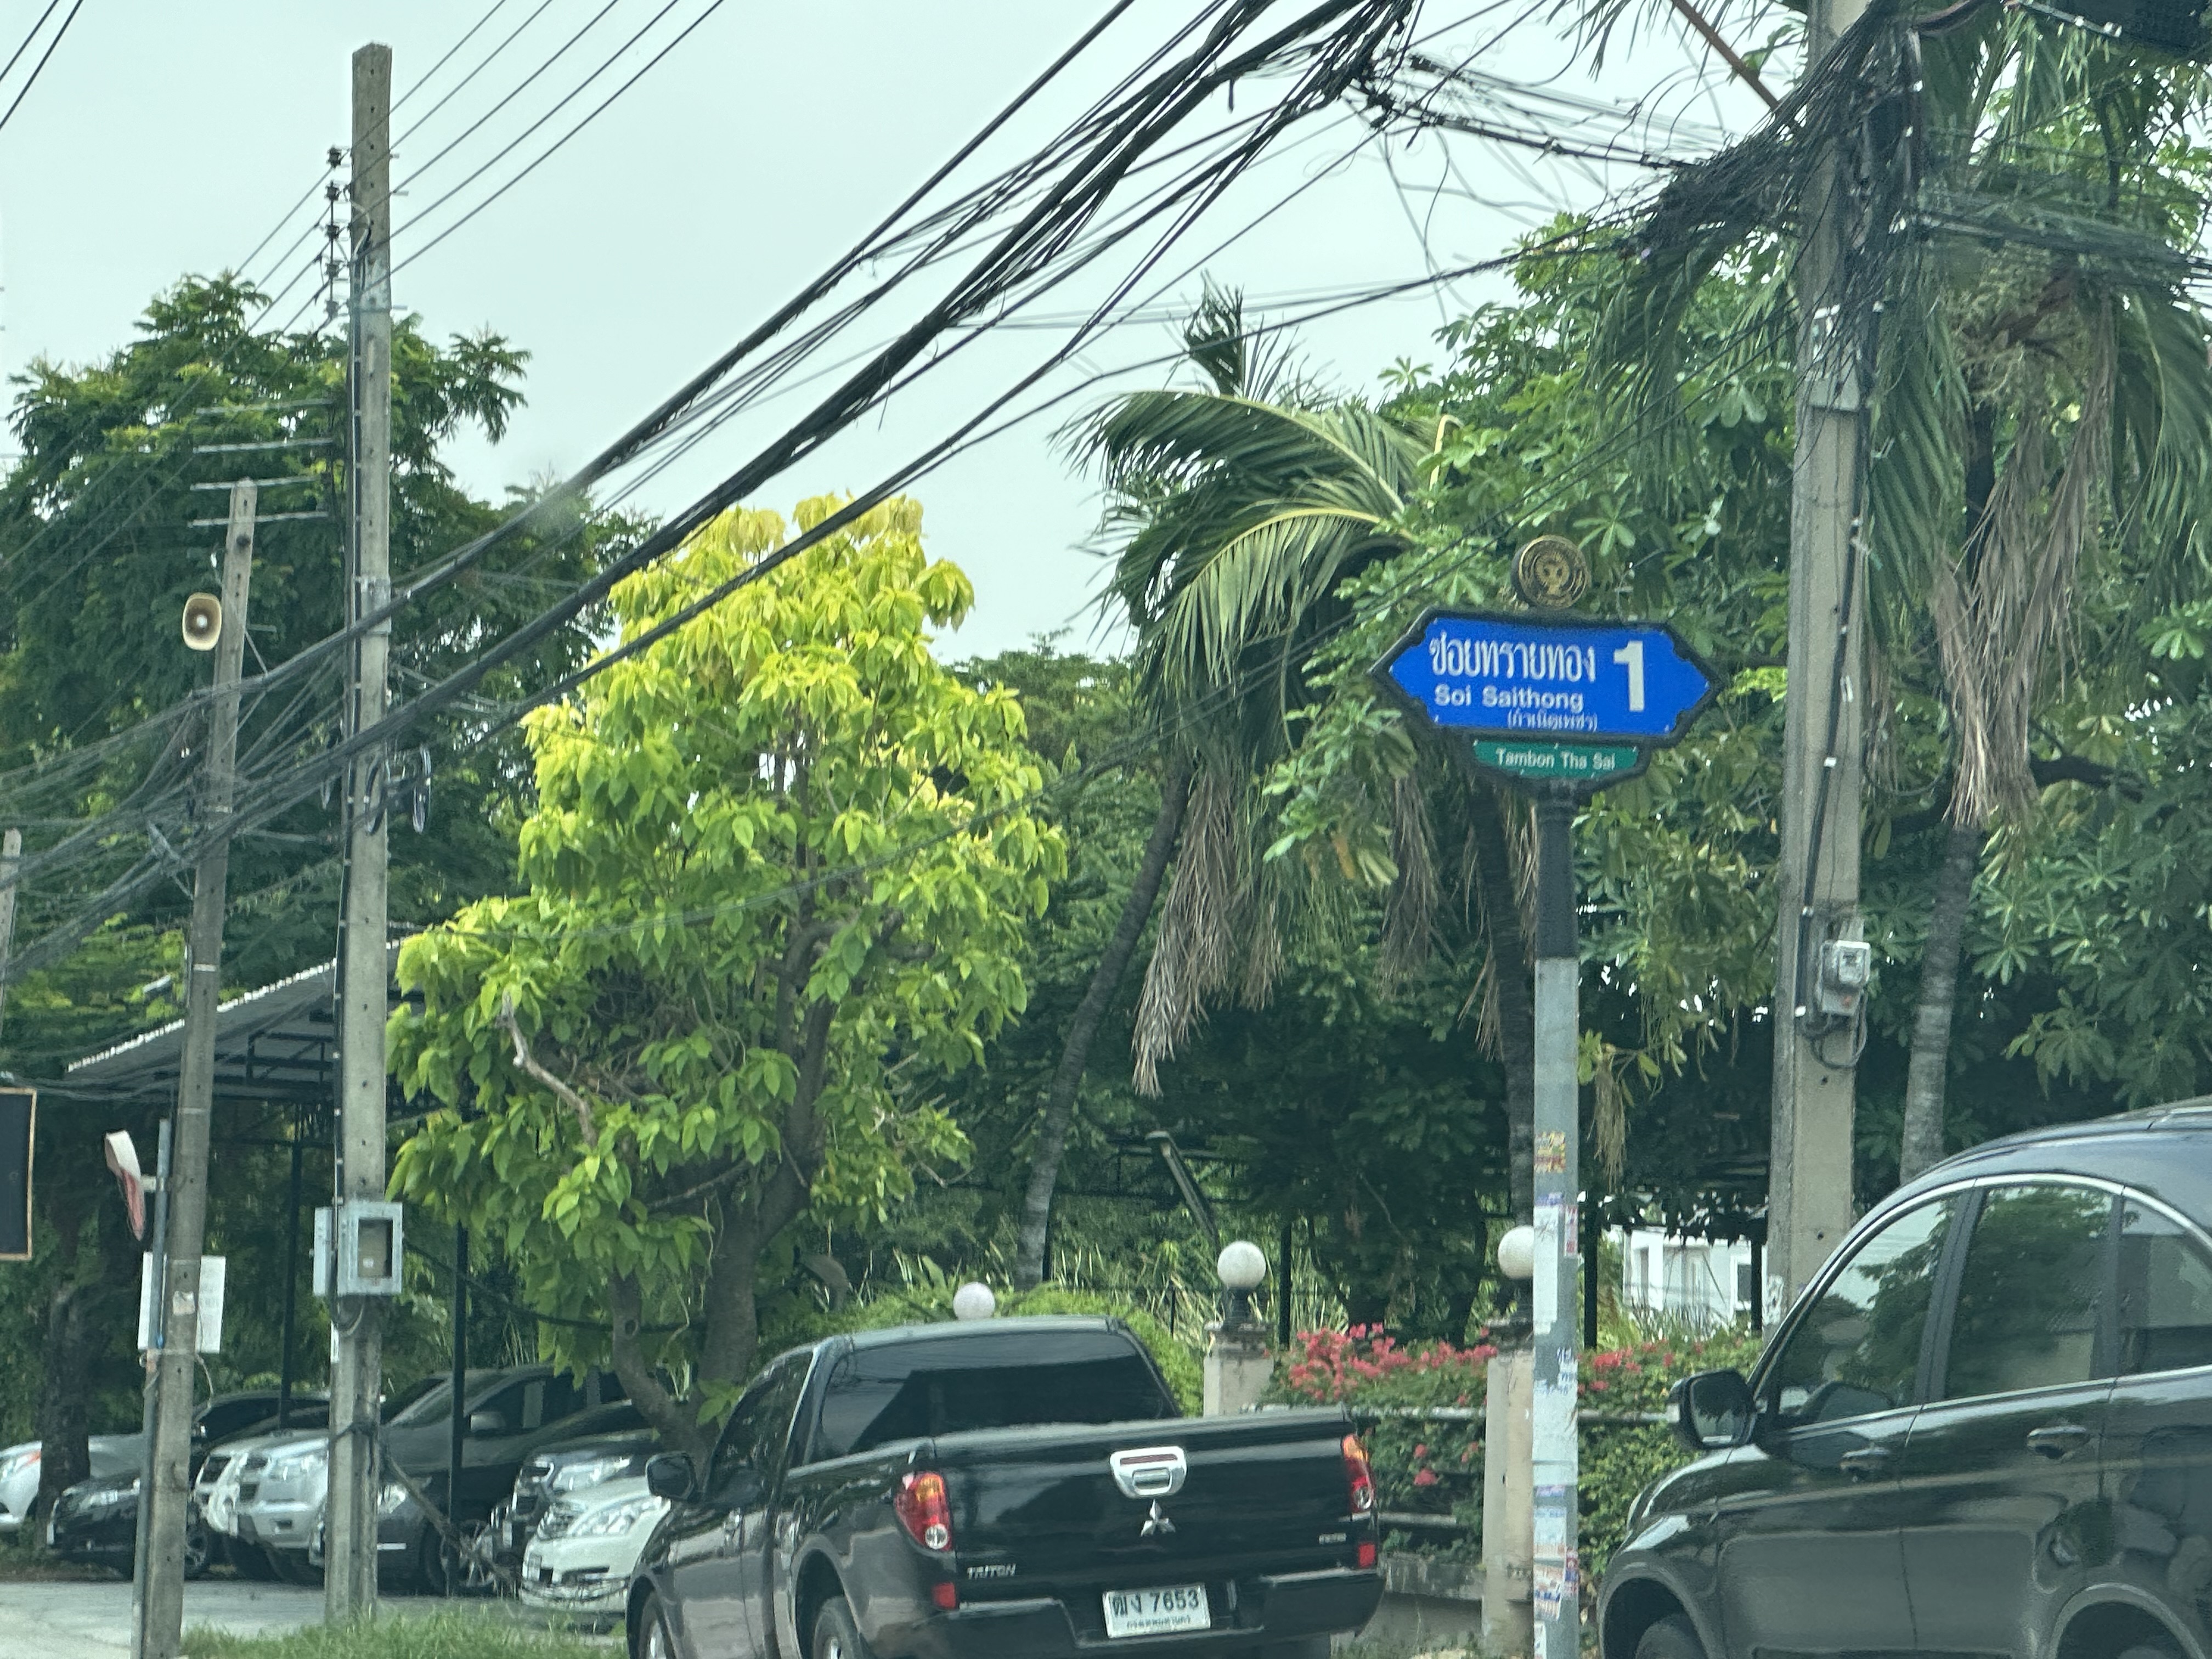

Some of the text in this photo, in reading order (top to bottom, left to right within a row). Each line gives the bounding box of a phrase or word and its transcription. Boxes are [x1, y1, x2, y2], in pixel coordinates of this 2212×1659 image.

[1429, 631, 1645, 712] ซอยทรายทอง 1
[1434, 684, 1584, 714] Soi Saithong
[1496, 747, 1616, 771] Tambon Tha Sai
[967, 1563, 1016, 1580] TRITON
[1149, 1589, 1199, 1613] 7653
